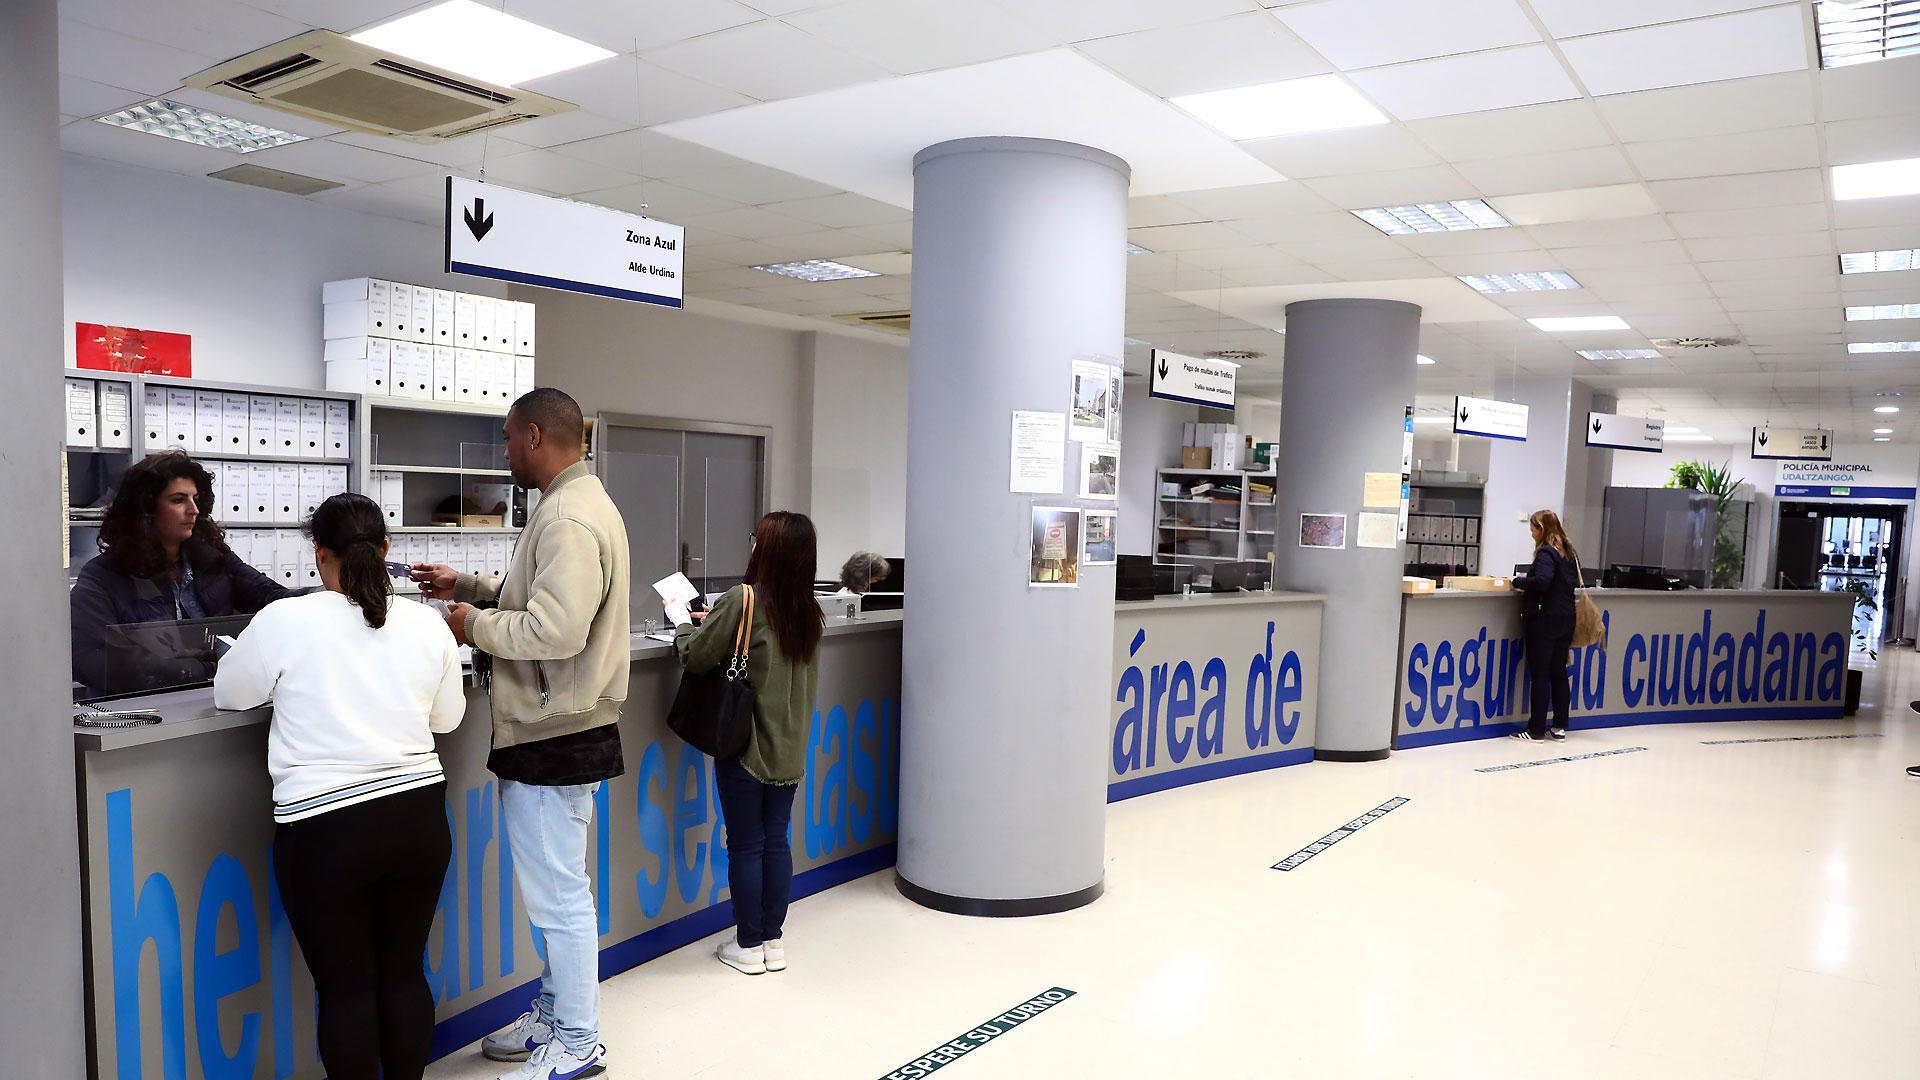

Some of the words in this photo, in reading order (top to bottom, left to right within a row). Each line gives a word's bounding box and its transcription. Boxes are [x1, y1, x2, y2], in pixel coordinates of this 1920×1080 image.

[626, 230, 651, 246] Zona
[654, 236, 676, 250] Azul
[629, 262, 647, 273] Alde
[649, 266, 674, 278] Urdina
[1184, 363, 1193, 372] Pago
[1784, 463, 1819, 471] POLICÍA
[1622, 609, 1844, 708] ciudadana
[1113, 628, 1227, 775] área
[1245, 622, 1301, 750] de
[887, 1039, 976, 1080] ESPERE
[966, 1024, 1003, 1042] SU
[995, 990, 1066, 1026] TURNO
